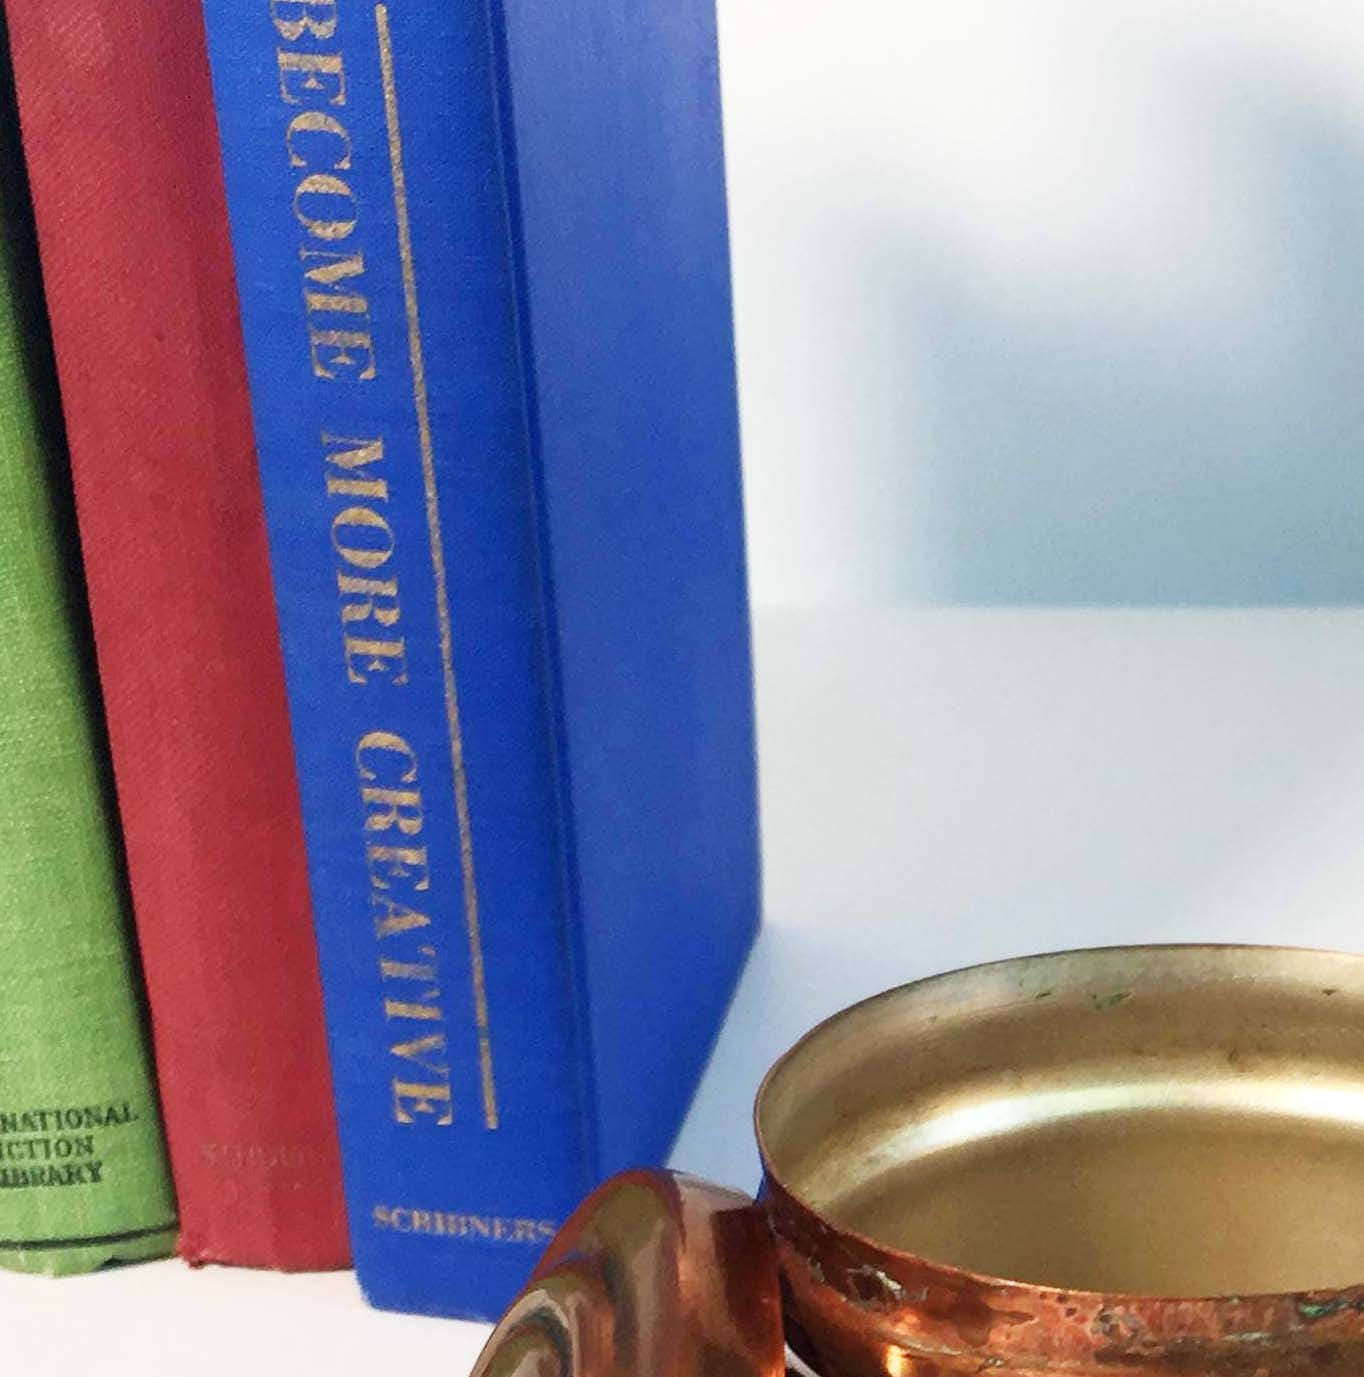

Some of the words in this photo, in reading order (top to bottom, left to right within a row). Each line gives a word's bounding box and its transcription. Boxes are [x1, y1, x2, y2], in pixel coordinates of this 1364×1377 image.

[269, 0, 376, 381] BECOME
[321, 428, 408, 685] MORE
[356, 731, 453, 1125] CREATIVE
[0, 1104, 139, 1133] NATIONAL
